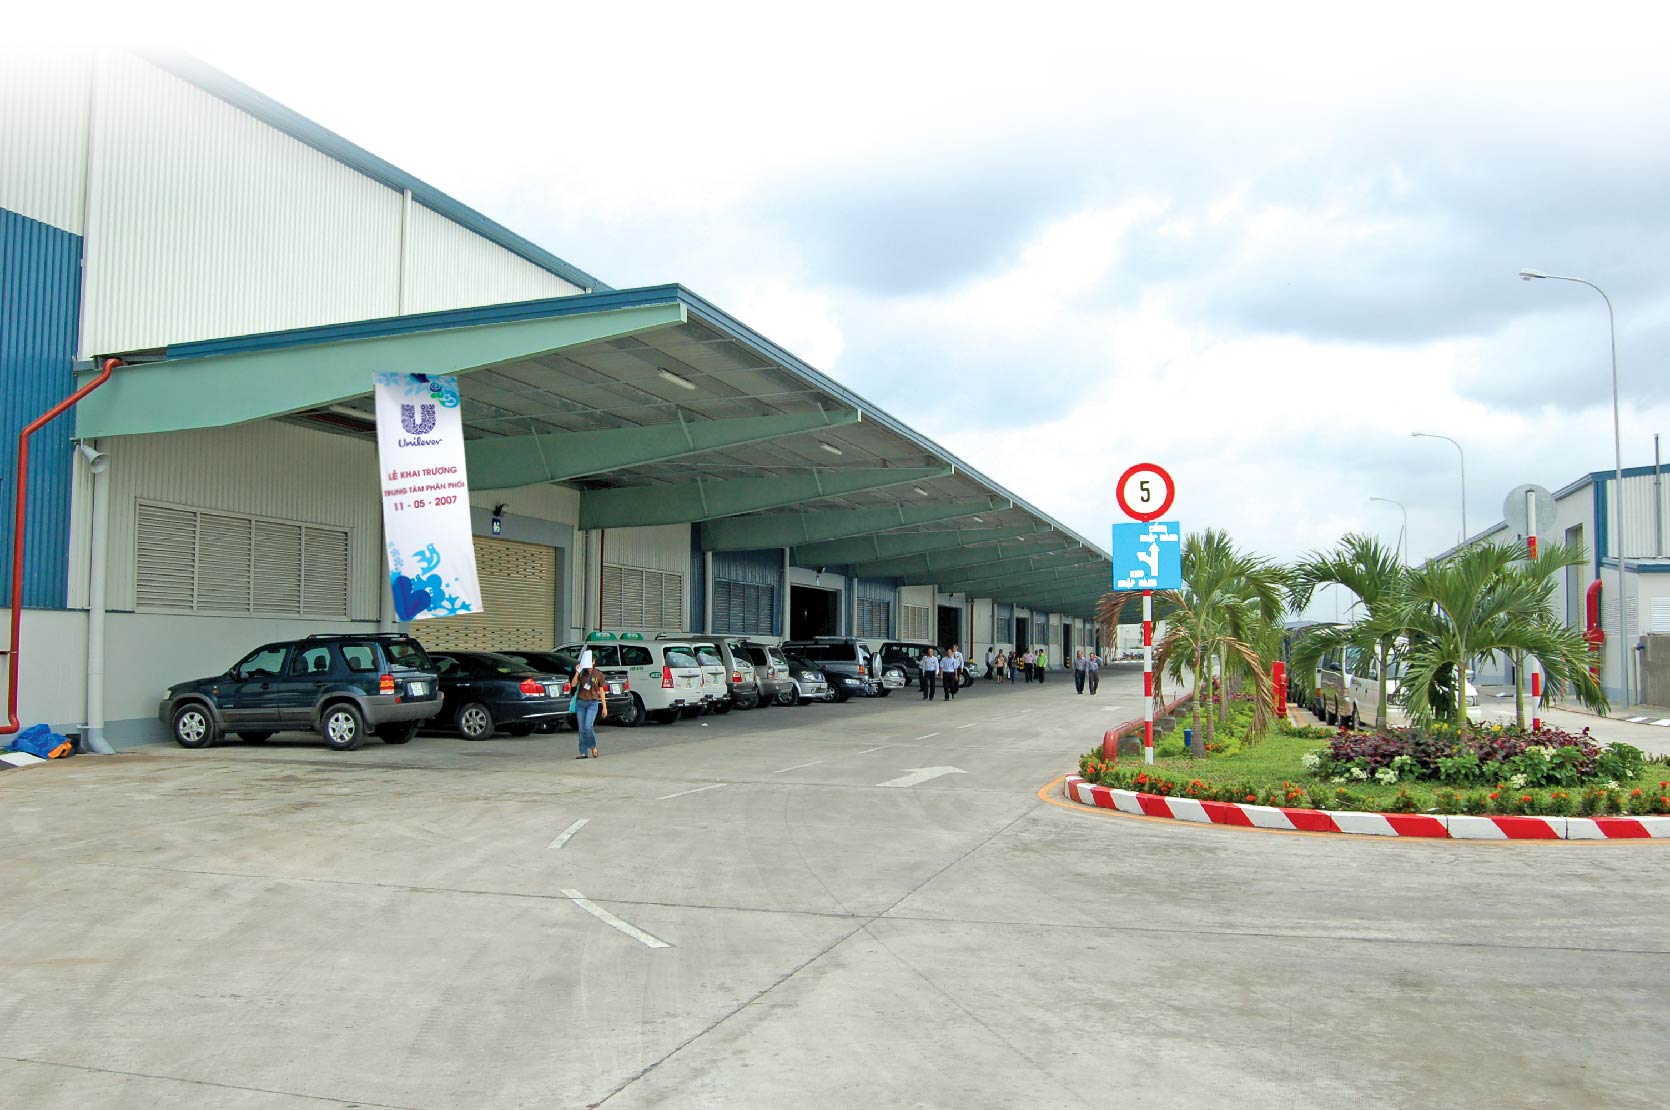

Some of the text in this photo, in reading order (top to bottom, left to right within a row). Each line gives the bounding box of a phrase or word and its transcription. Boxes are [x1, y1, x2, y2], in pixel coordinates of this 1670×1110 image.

[398, 437, 443, 448] Unilever
[400, 470, 421, 479] KHAI
[384, 487, 408, 497] TRUNG
[409, 484, 425, 494] TÂM
[426, 482, 446, 492] PHÂN
[1139, 480, 1151, 503] 5
[394, 501, 404, 511] 11
[413, 499, 426, 509] 05
[435, 495, 457, 507] 2007
